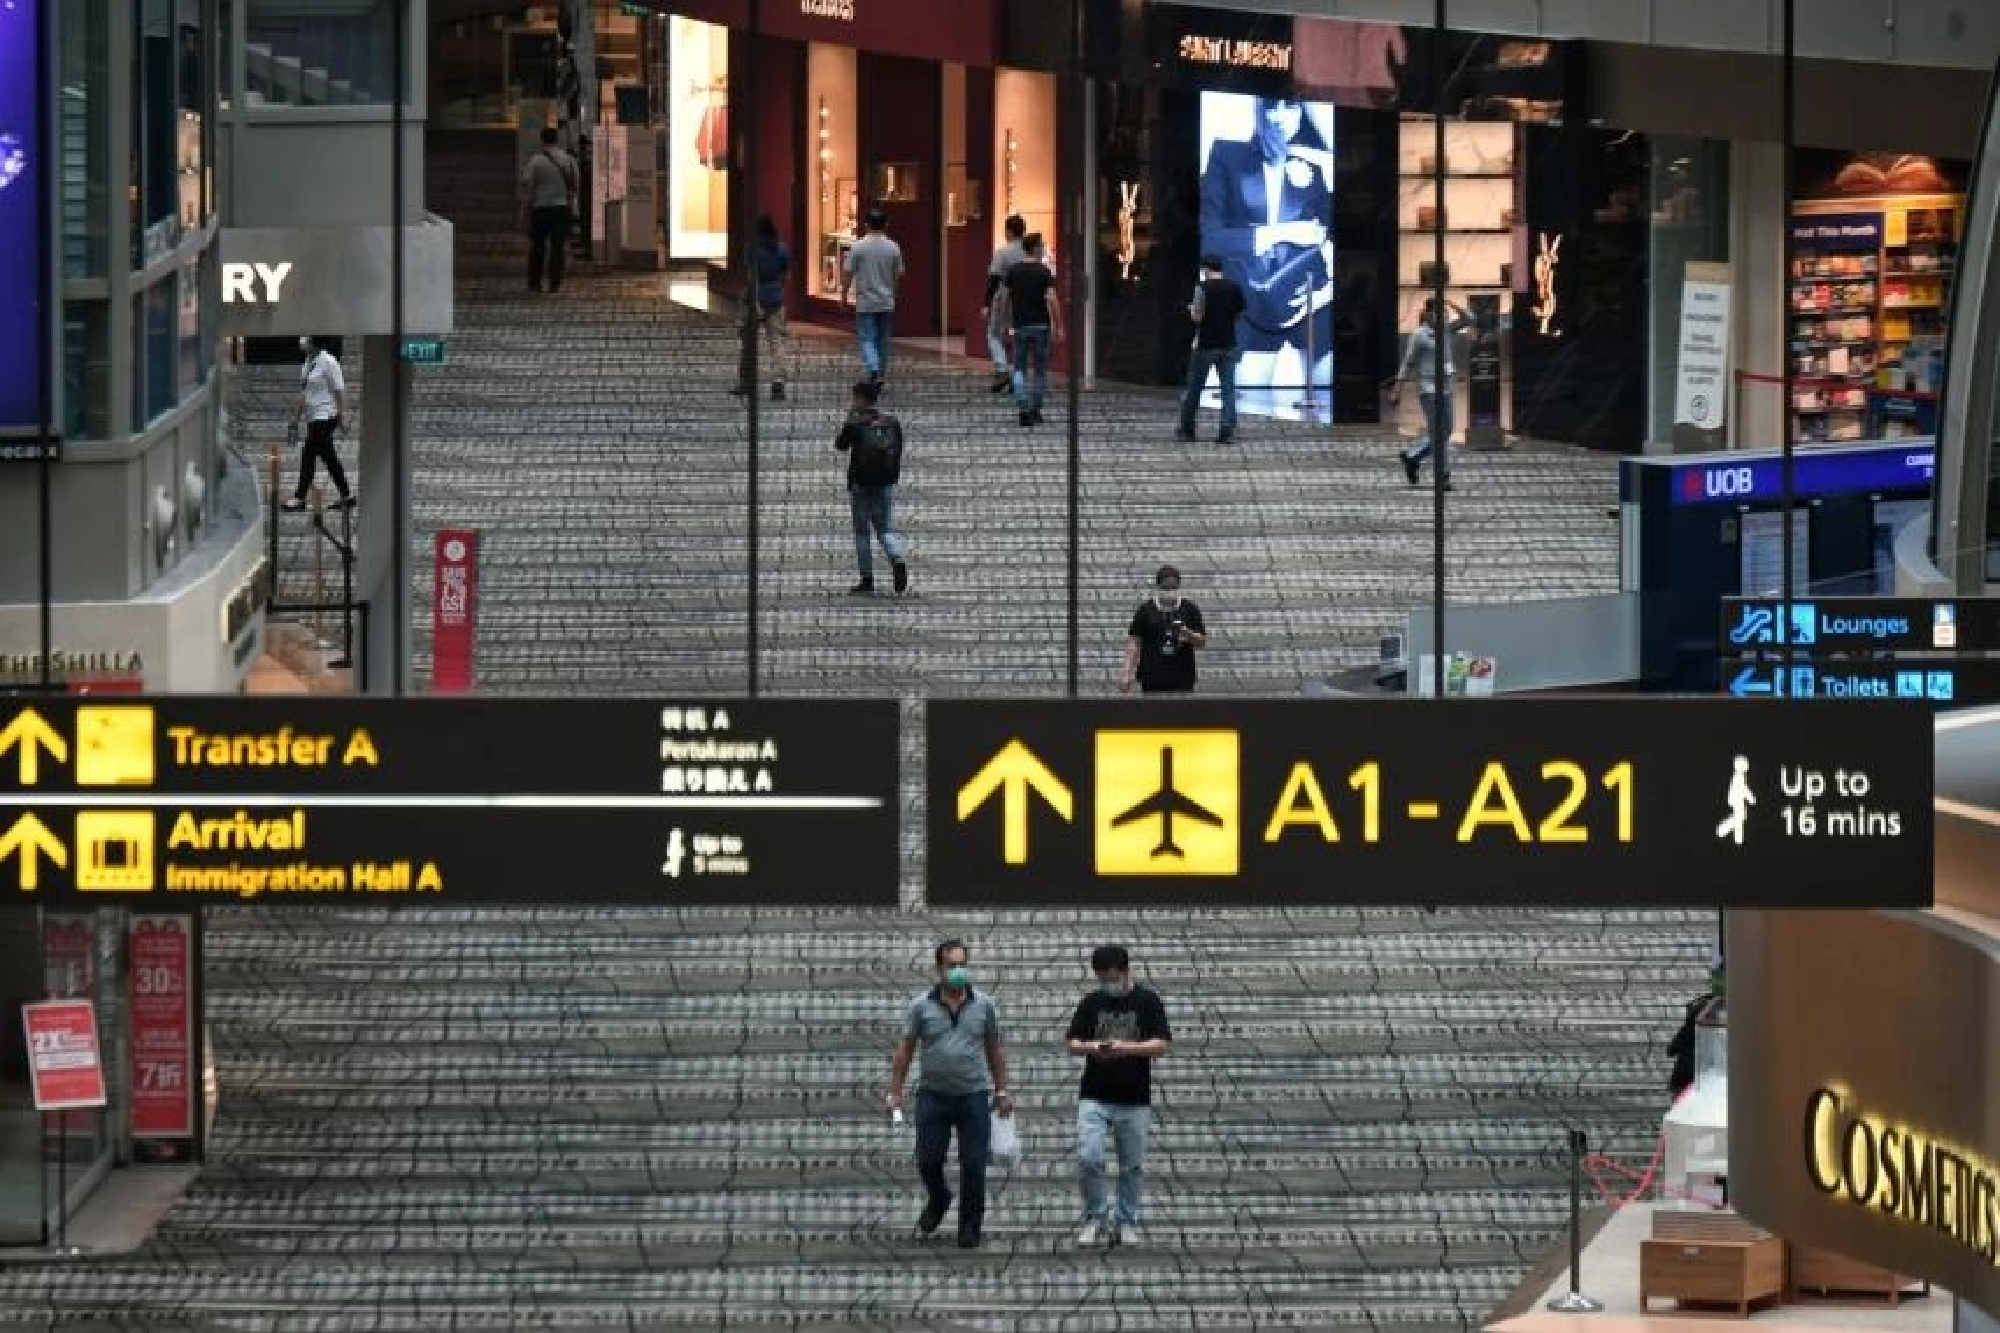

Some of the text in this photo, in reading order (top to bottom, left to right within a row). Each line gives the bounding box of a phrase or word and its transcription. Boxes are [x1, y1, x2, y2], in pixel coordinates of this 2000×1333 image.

[222, 262, 292, 302] RY
[1706, 468, 1753, 497] UOB
[1822, 614, 1908, 639] Lounges
[51, 650, 142, 671] SHILLA
[1821, 675, 1890, 698] Toilets
[711, 709, 730, 731] A
[166, 721, 380, 766] Transfer A
[760, 737, 778, 761] A
[754, 768, 772, 792] A
[1780, 763, 1870, 803] Up to
[166, 809, 306, 850] Arrival
[1780, 804, 1901, 837] 16 mins
[165, 860, 444, 898] Immigration Hall A
[1804, 1086, 1997, 1263] COSMETICS
